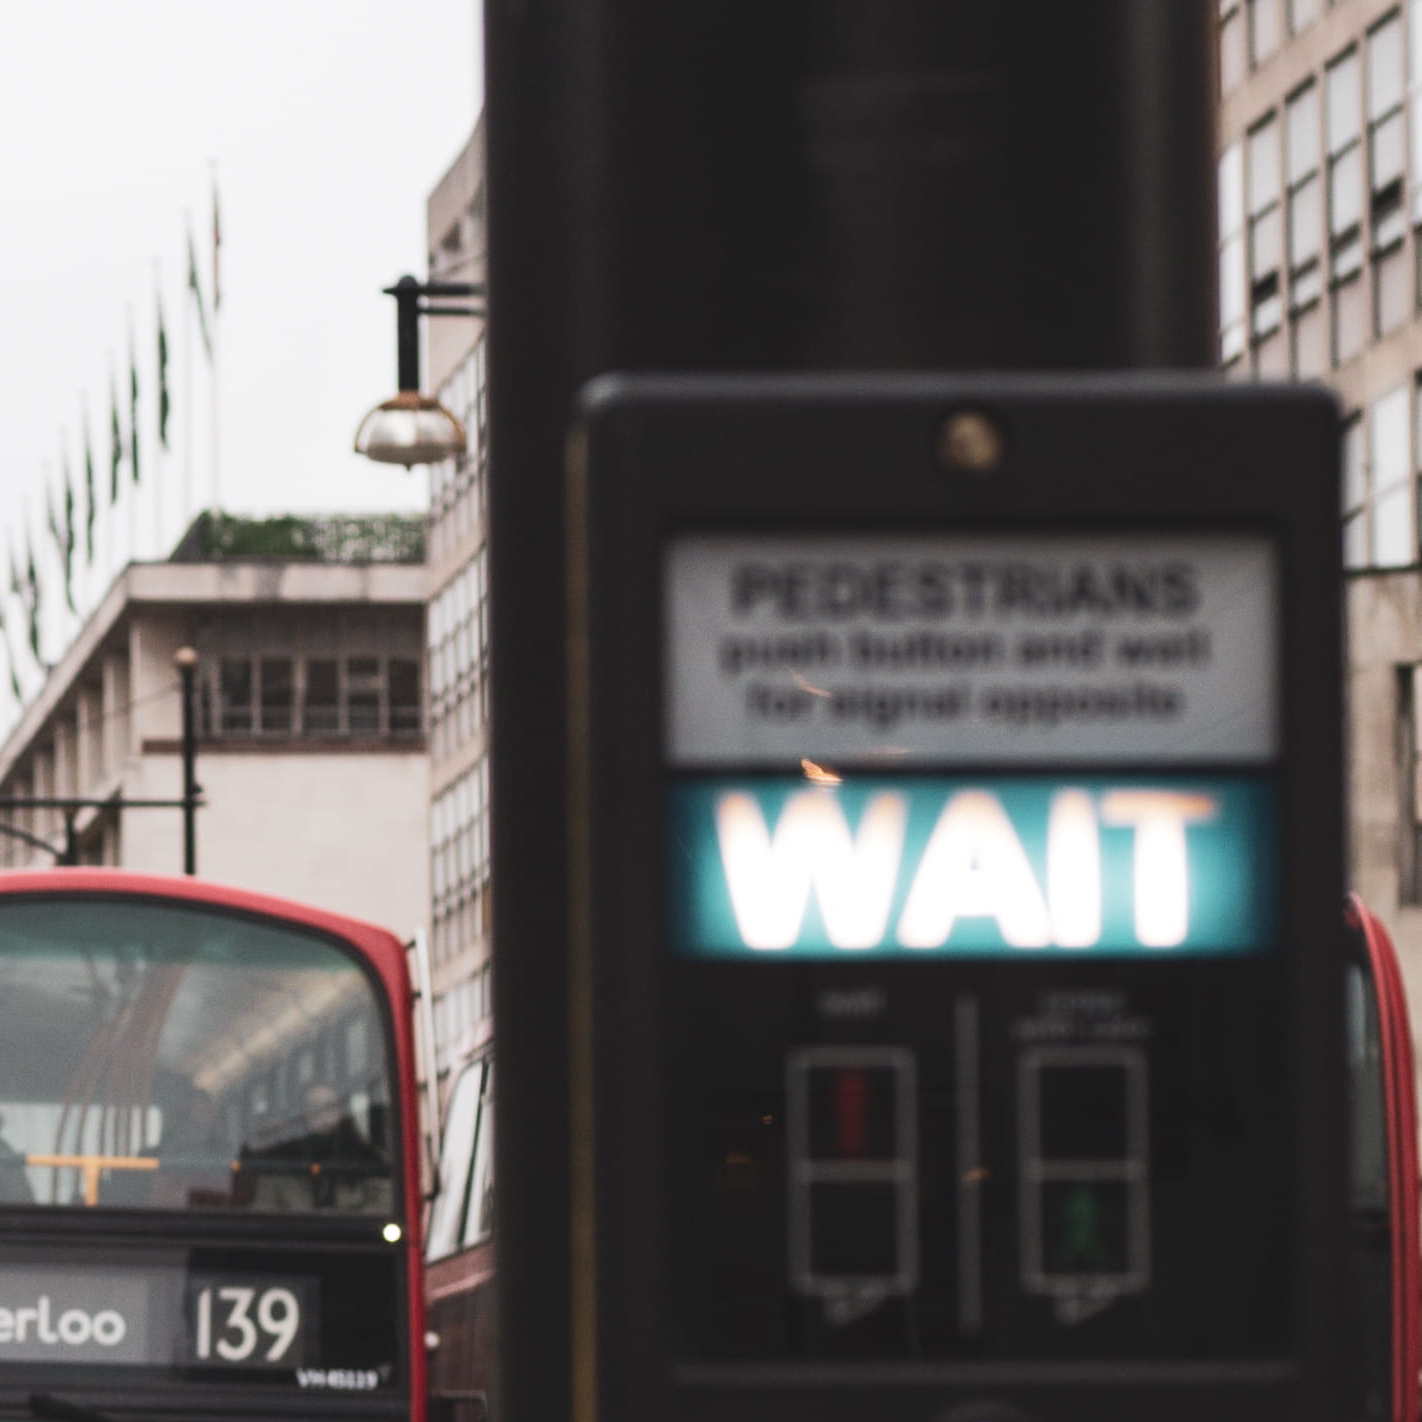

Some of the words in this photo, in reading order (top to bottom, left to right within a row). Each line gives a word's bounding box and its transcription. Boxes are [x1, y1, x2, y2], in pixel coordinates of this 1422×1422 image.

[727, 563, 1200, 622] PEDESTRIANS
[717, 630, 837, 677] push
[849, 630, 1004, 670] button
[1014, 630, 1105, 670] and
[1114, 627, 1212, 671] wait
[746, 683, 816, 722] for
[825, 683, 970, 734] signal
[978, 683, 1187, 727] opposite
[714, 789, 1217, 949] WAIT
[195, 1287, 300, 1362] 139
